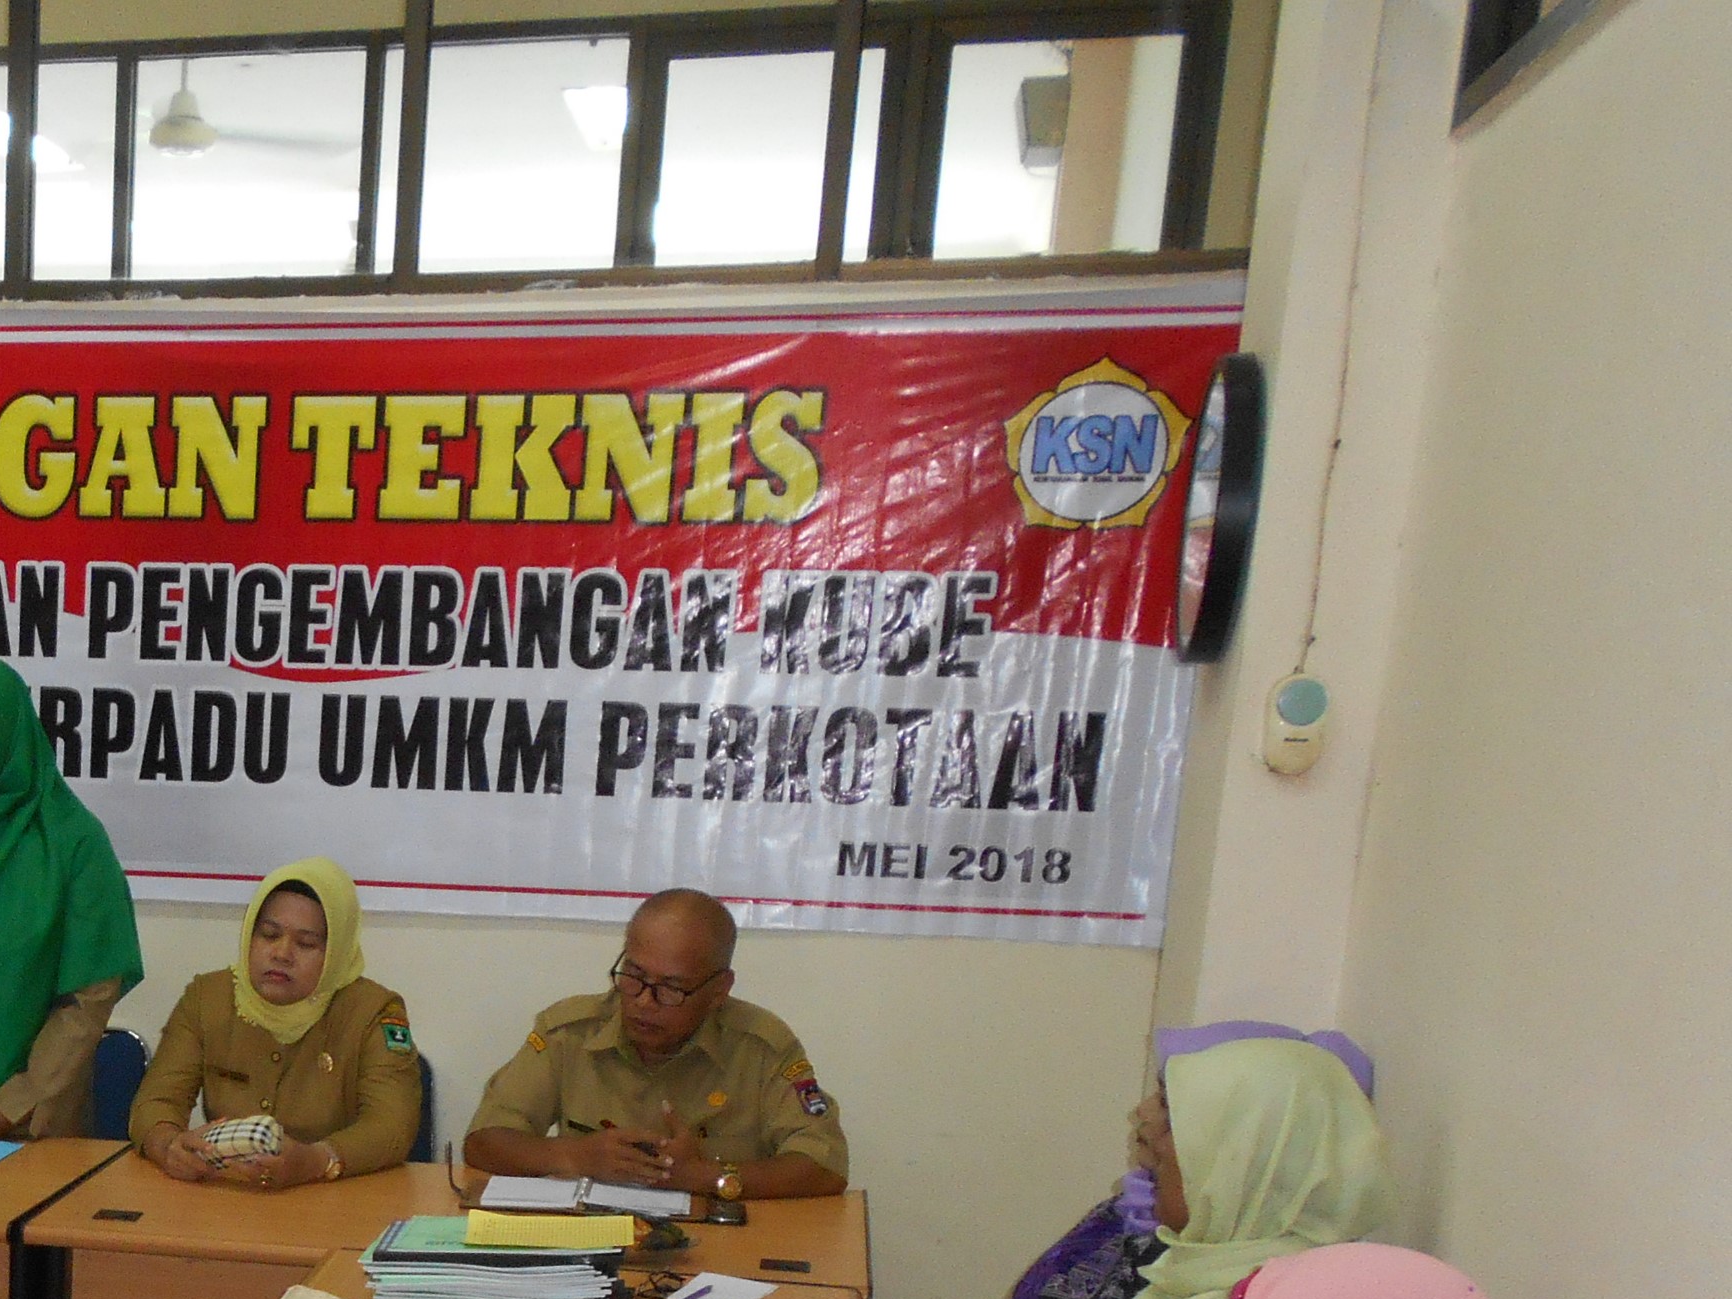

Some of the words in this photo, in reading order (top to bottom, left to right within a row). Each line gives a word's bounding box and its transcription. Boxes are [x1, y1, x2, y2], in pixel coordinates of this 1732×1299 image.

[291, 388, 825, 526] TEKNIS
[1031, 413, 1159, 475] KSN
[87, 564, 730, 674] PENGEMBANGAN
[762, 570, 999, 679] KUBE
[35, 685, 291, 786] RPADU
[317, 696, 568, 796] UMKM
[595, 700, 1108, 814] PERKOTAAN
[836, 840, 926, 879] MEI
[946, 842, 1072, 885] 2018
